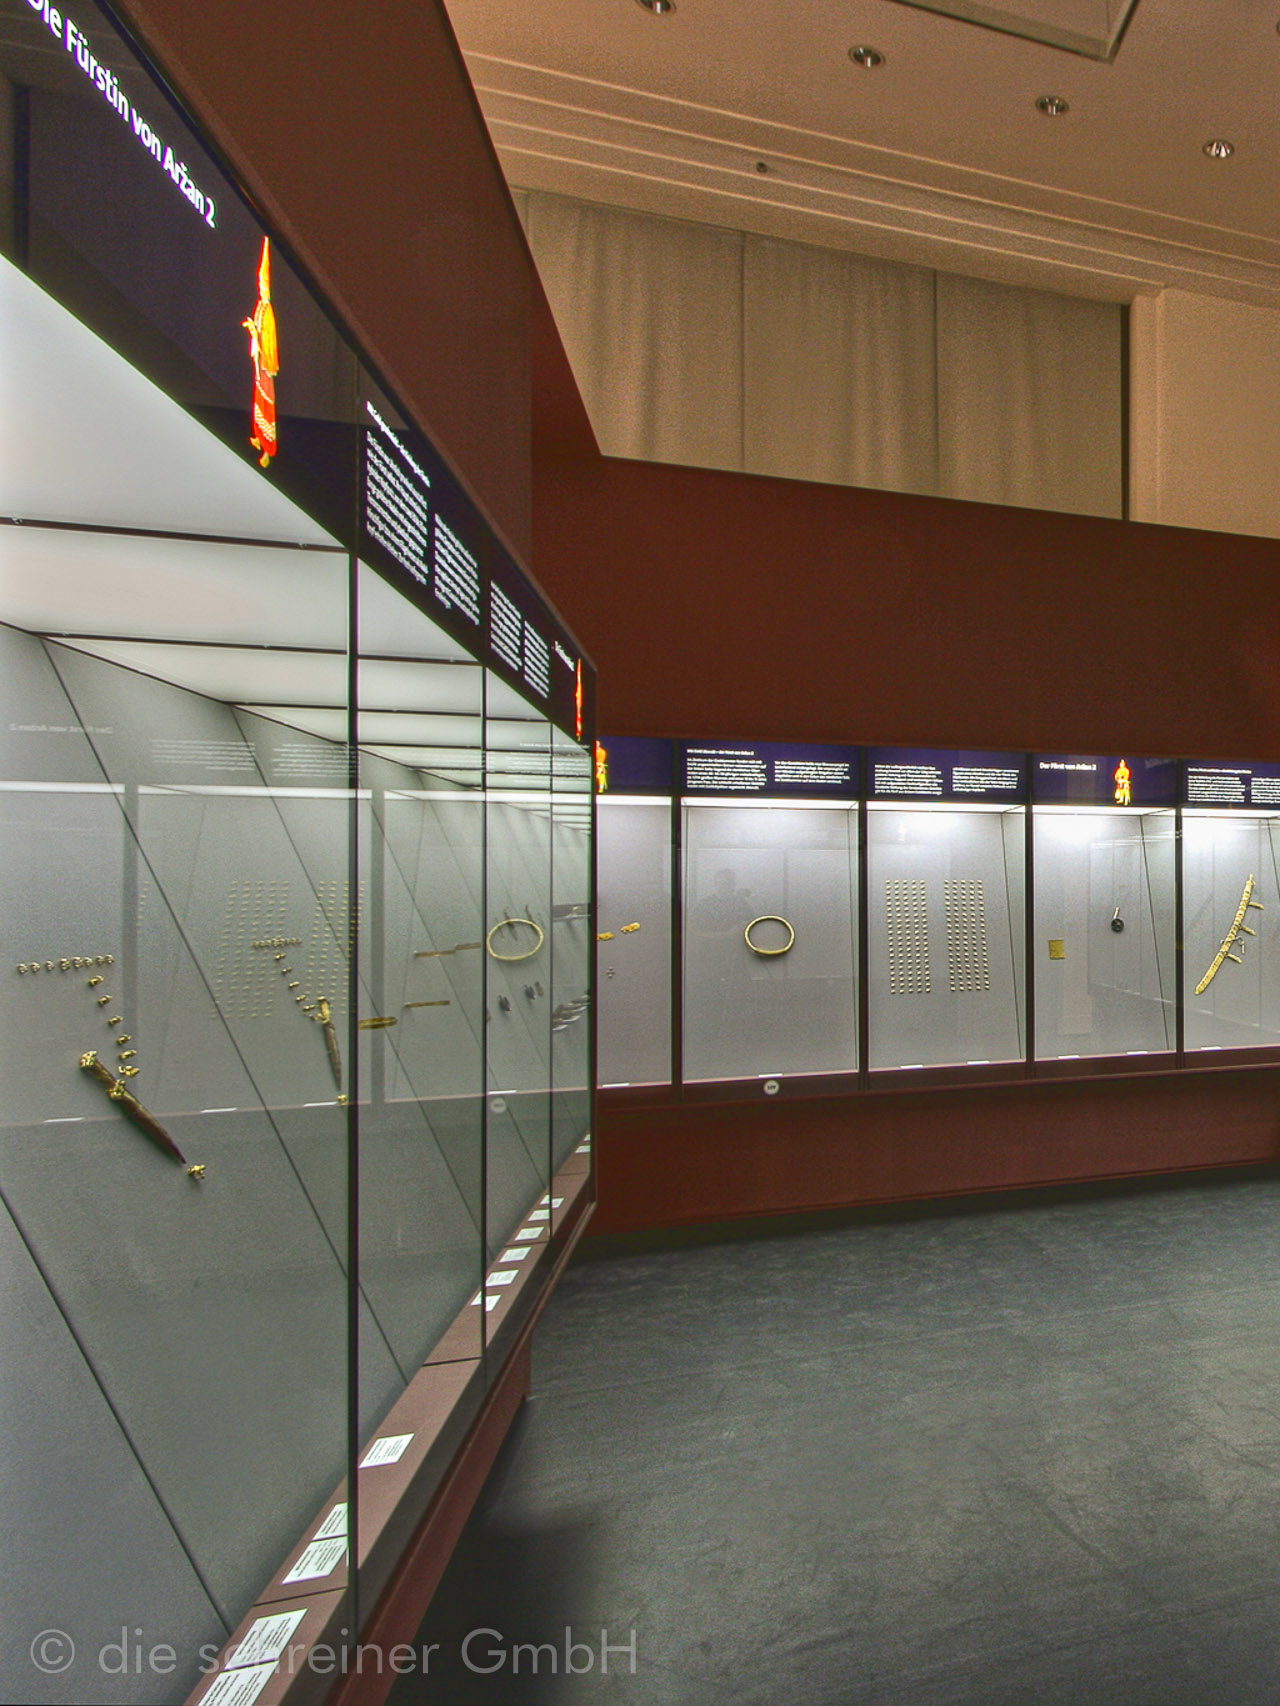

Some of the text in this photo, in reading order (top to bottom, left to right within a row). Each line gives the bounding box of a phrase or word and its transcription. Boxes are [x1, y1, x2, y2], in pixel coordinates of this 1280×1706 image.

[27, 0, 217, 229] ie Fürstin von Aržan 2
